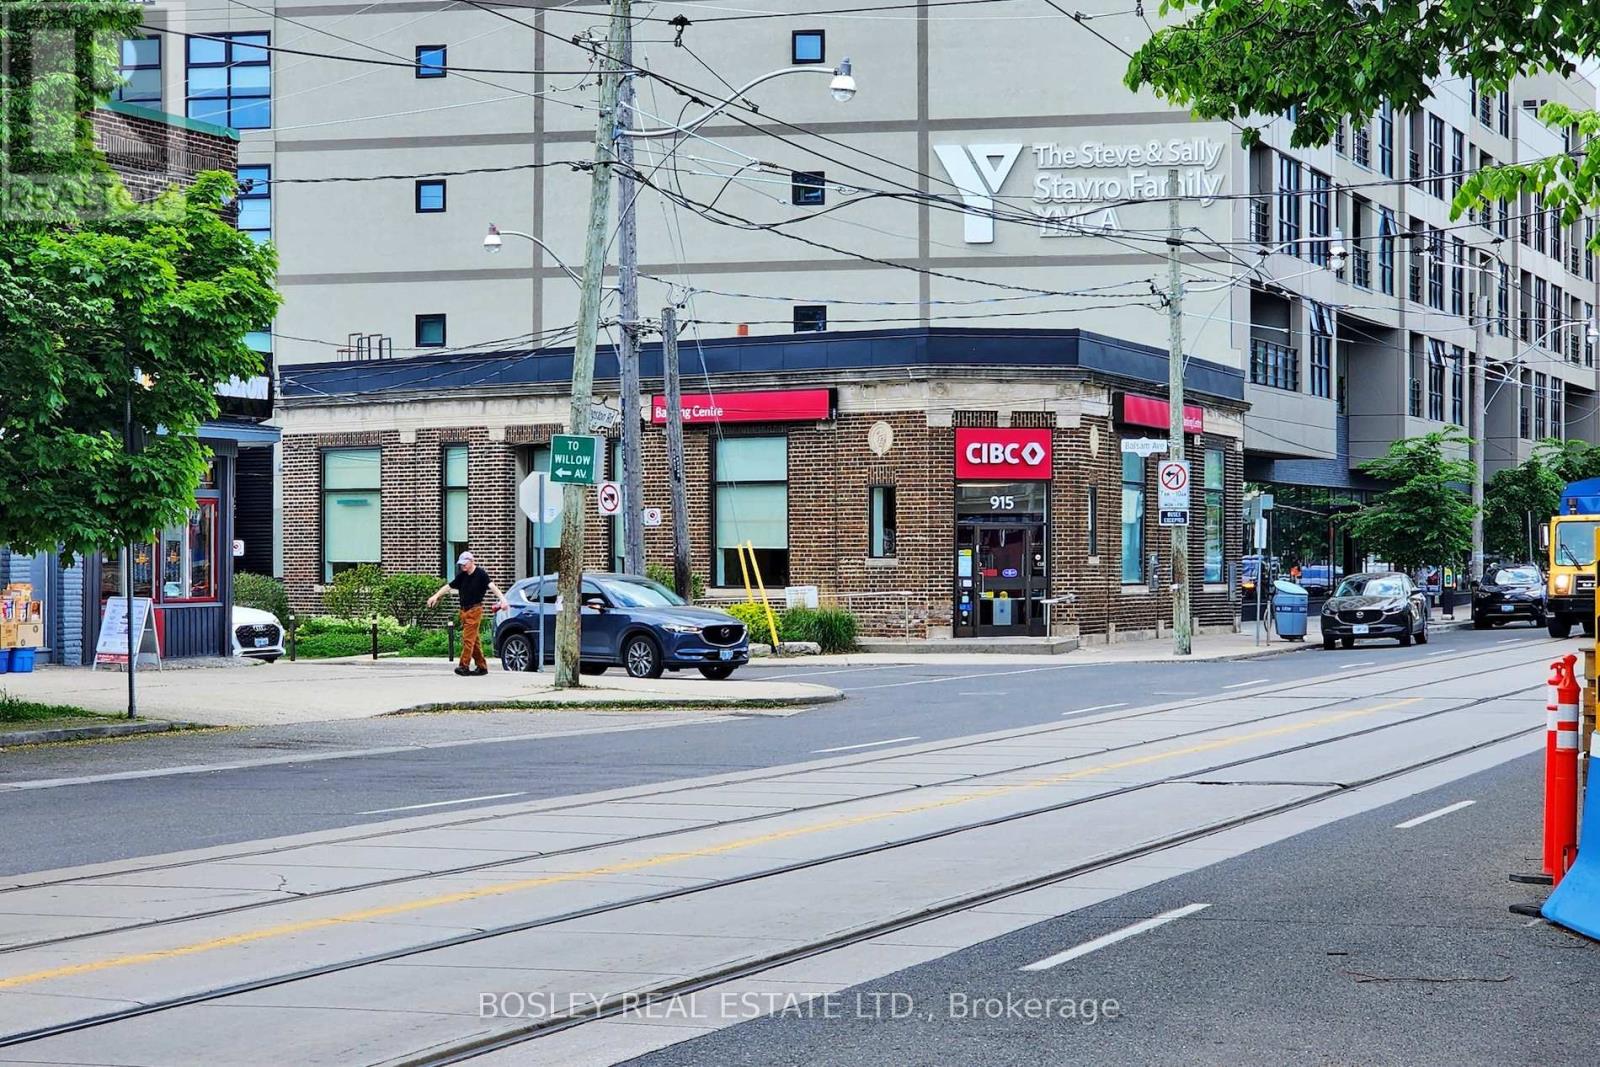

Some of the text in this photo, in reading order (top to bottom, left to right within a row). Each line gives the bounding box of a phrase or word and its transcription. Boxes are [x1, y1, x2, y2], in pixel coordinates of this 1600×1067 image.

[1035, 140, 1225, 170] The Steve & Sally
[1033, 173, 1122, 202] Stavro
[655, 405, 723, 420] Bang Centre
[567, 440, 580, 451] TO
[1125, 439, 1165, 450] Balsam Ave
[554, 454, 591, 466] WILLOW
[966, 442, 1020, 464] CIBC
[990, 495, 1014, 510] 915
